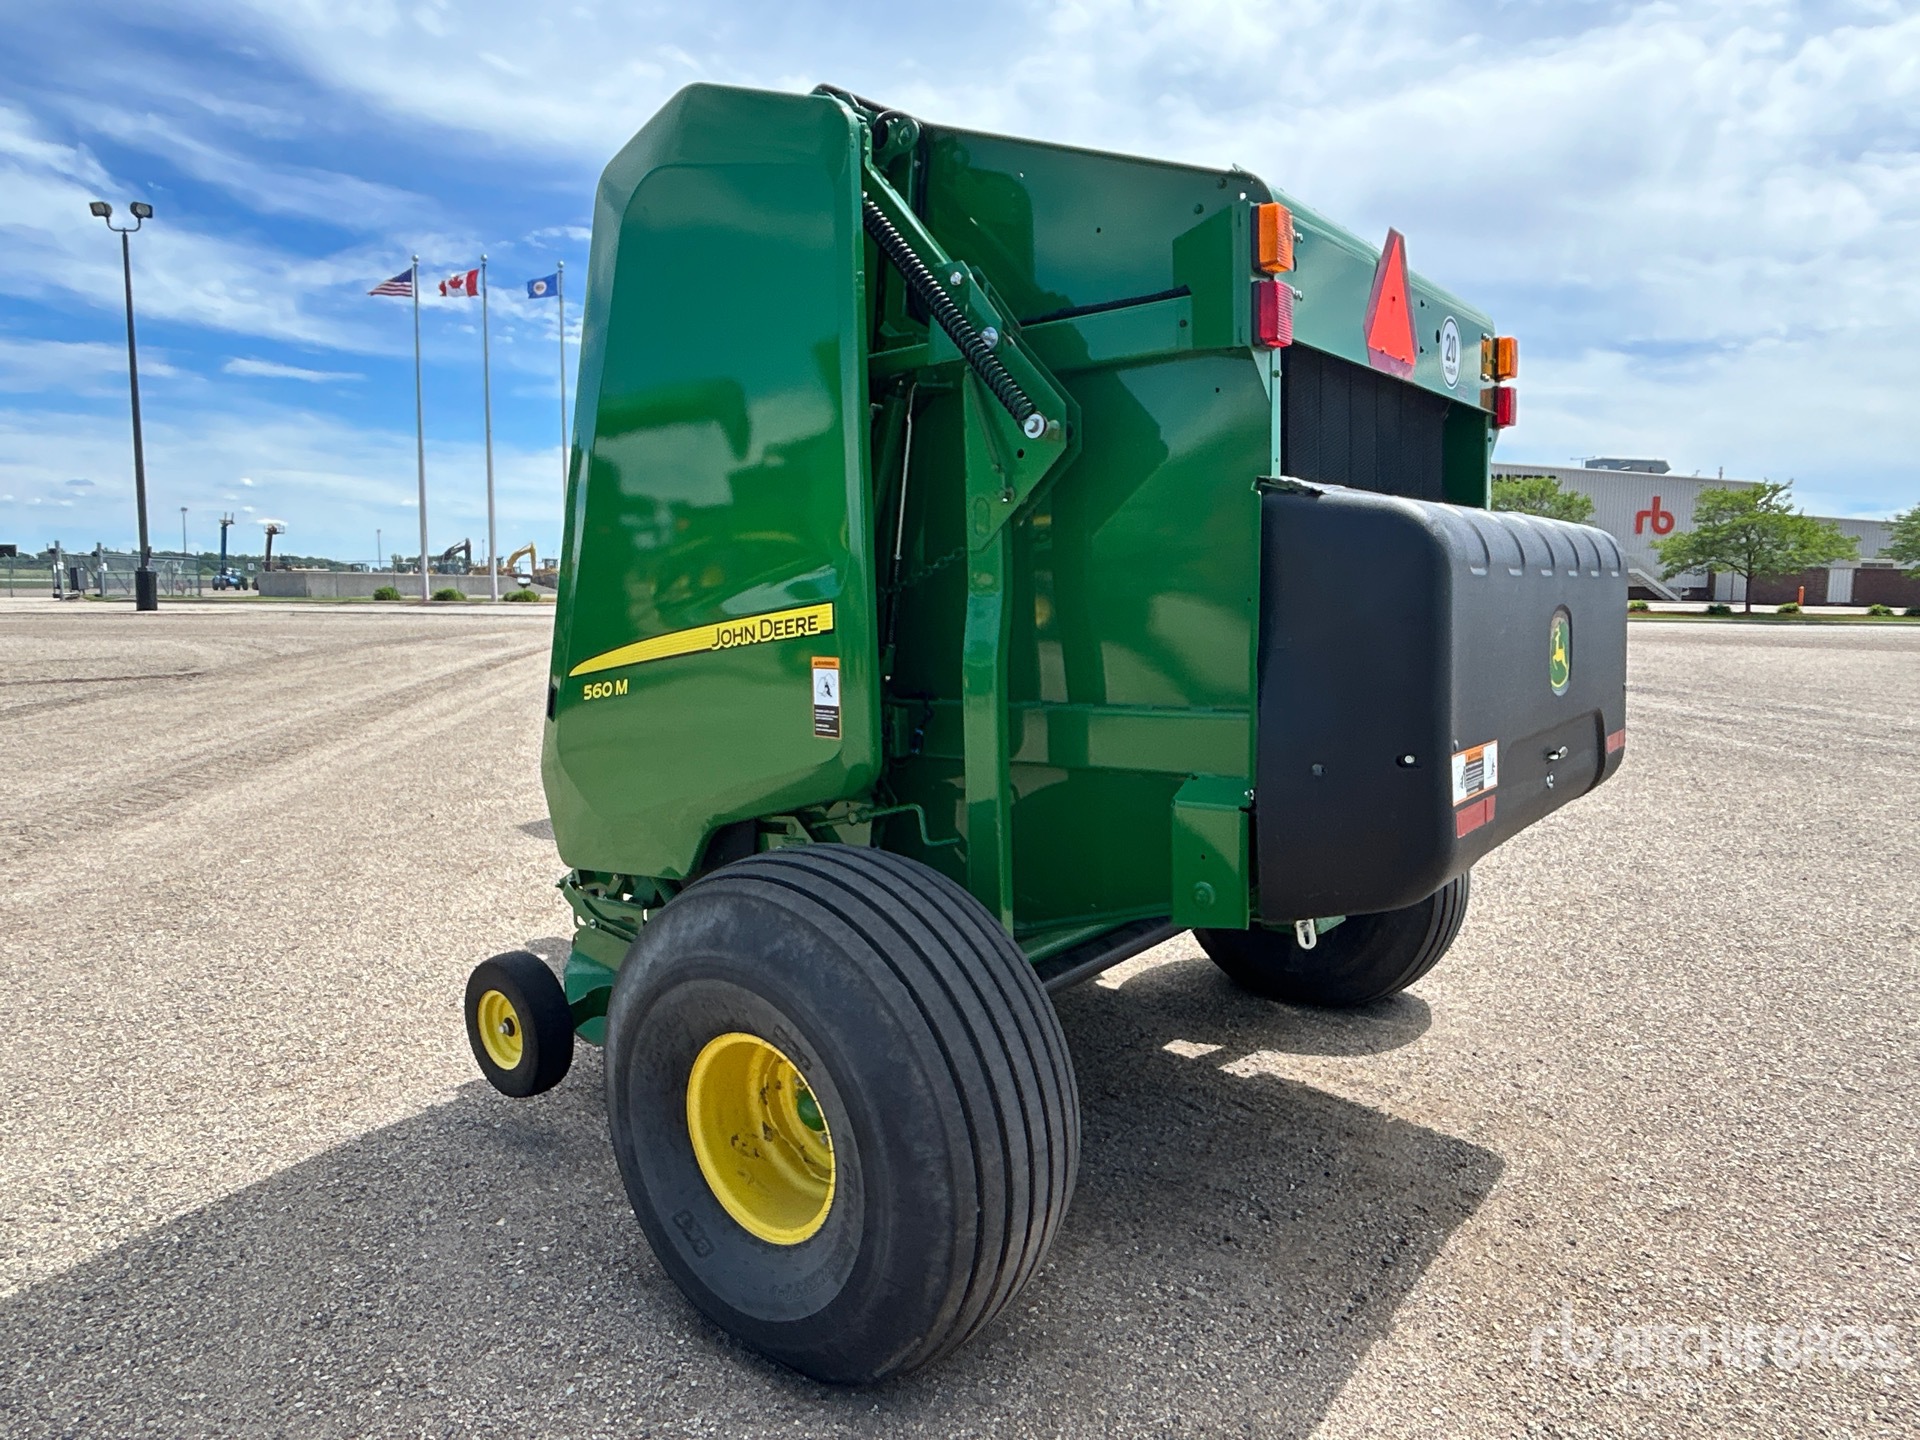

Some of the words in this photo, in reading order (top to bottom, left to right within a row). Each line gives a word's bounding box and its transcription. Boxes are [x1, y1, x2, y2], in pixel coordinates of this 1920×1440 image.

[1445, 333, 1457, 364] 20
[1635, 496, 1675, 535] rb
[711, 625, 756, 648] JOHN
[760, 615, 819, 641] DEERE
[583, 682, 613, 700] 560
[615, 679, 628, 695] M
